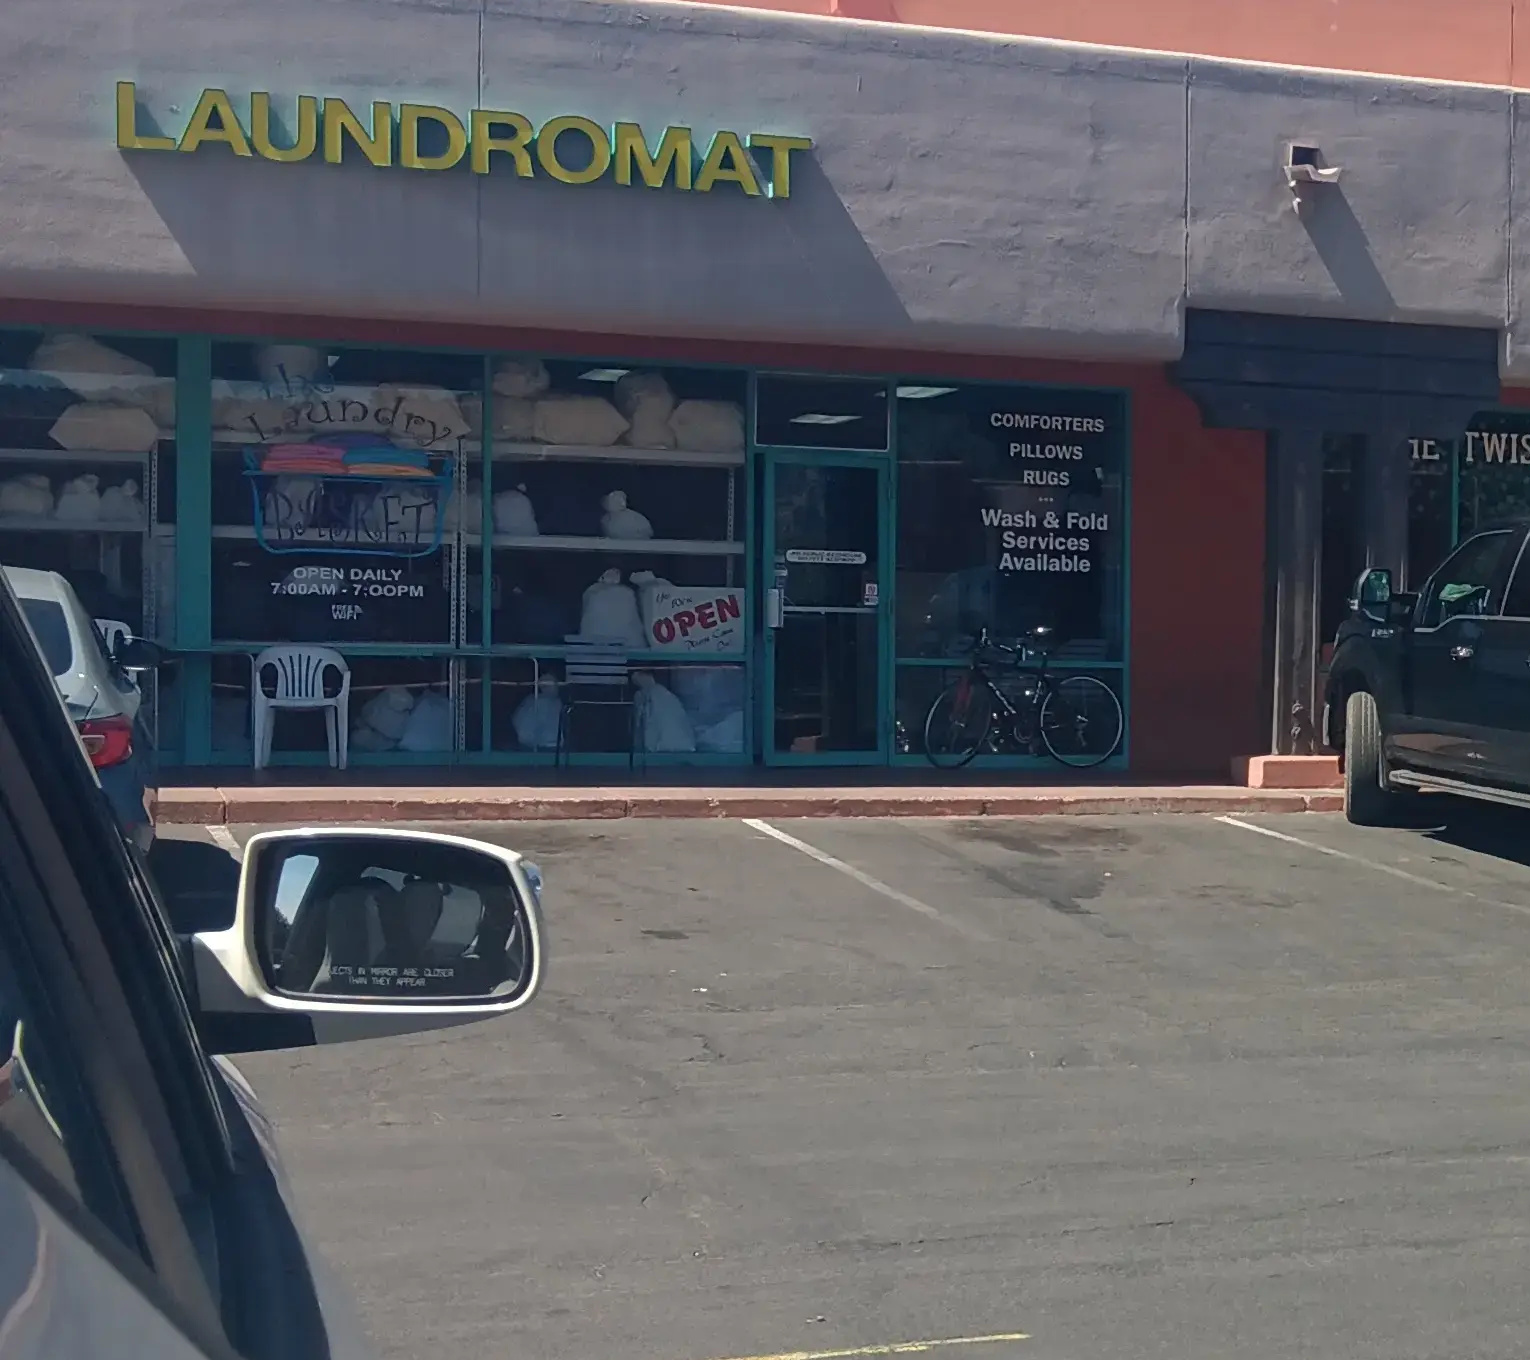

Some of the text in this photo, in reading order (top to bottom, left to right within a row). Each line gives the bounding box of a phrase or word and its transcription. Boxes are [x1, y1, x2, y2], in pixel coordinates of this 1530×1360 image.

[117, 81, 813, 198] LAUNDROMAT
[243, 396, 453, 447] Laundry
[990, 413, 1105, 433] COMFORTERS
[1009, 443, 1083, 460] PILLOWS
[1023, 470, 1070, 486] RUGS
[264, 489, 438, 544] BASKET
[981, 508, 1108, 530] Wash & Fold
[1002, 531, 1090, 551] Services
[1000, 553, 1091, 573] Available
[294, 567, 402, 581] OPEN DAILY
[271, 582, 336, 596] 7:00AM
[352, 584, 424, 597] 7:00PM
[653, 594, 741, 644] OPEN
[349, 976, 368, 985] THAN
[371, 976, 392, 985] THEY
[357, 967, 365, 976] IN
[370, 967, 398, 976] MIRROR
[402, 967, 418, 977] ARE
